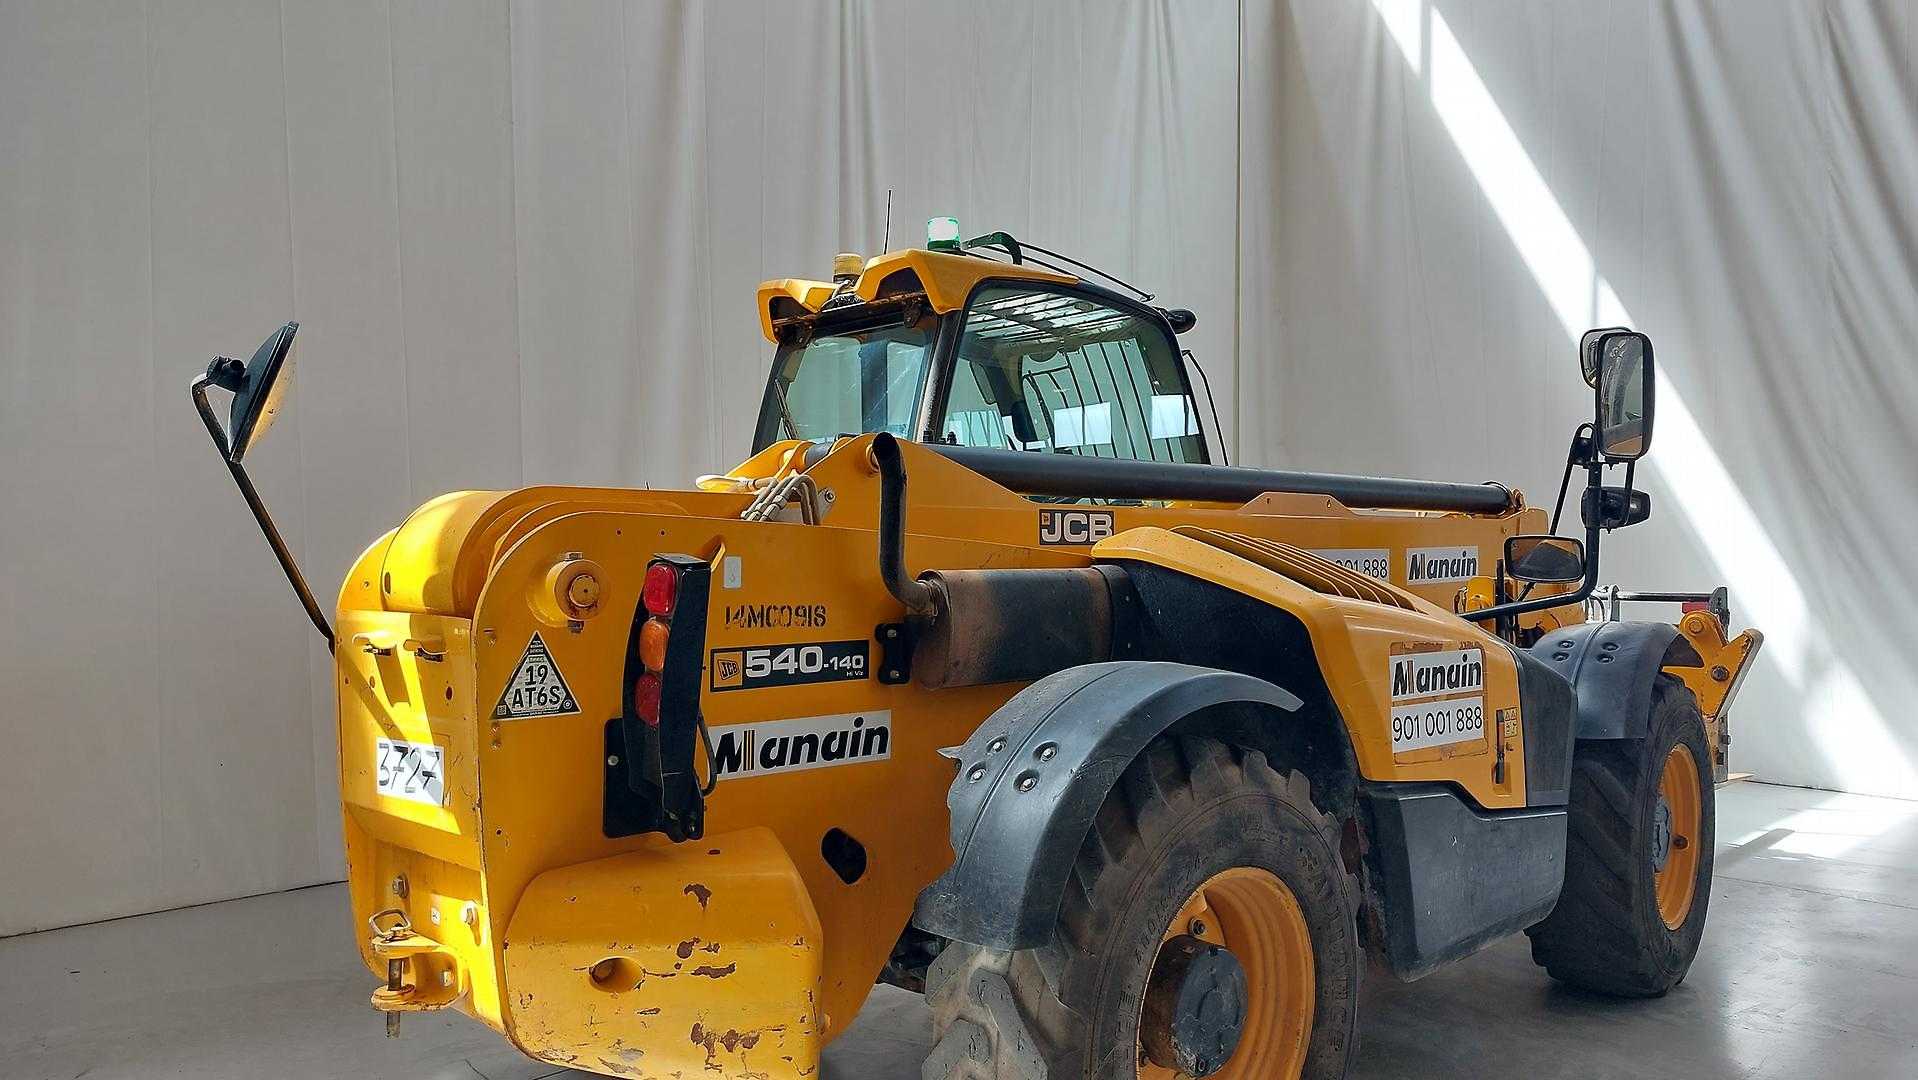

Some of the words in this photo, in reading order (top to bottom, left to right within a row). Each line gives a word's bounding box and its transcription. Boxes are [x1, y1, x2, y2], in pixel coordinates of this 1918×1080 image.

[1041, 512, 1113, 542] JCB
[1363, 558, 1388, 578] 888
[524, 664, 549, 686] 19
[1392, 714, 1421, 742] 901
[1425, 710, 1452, 737] 001
[1456, 705, 1483, 732] 888
[378, 742, 440, 794] 3727
